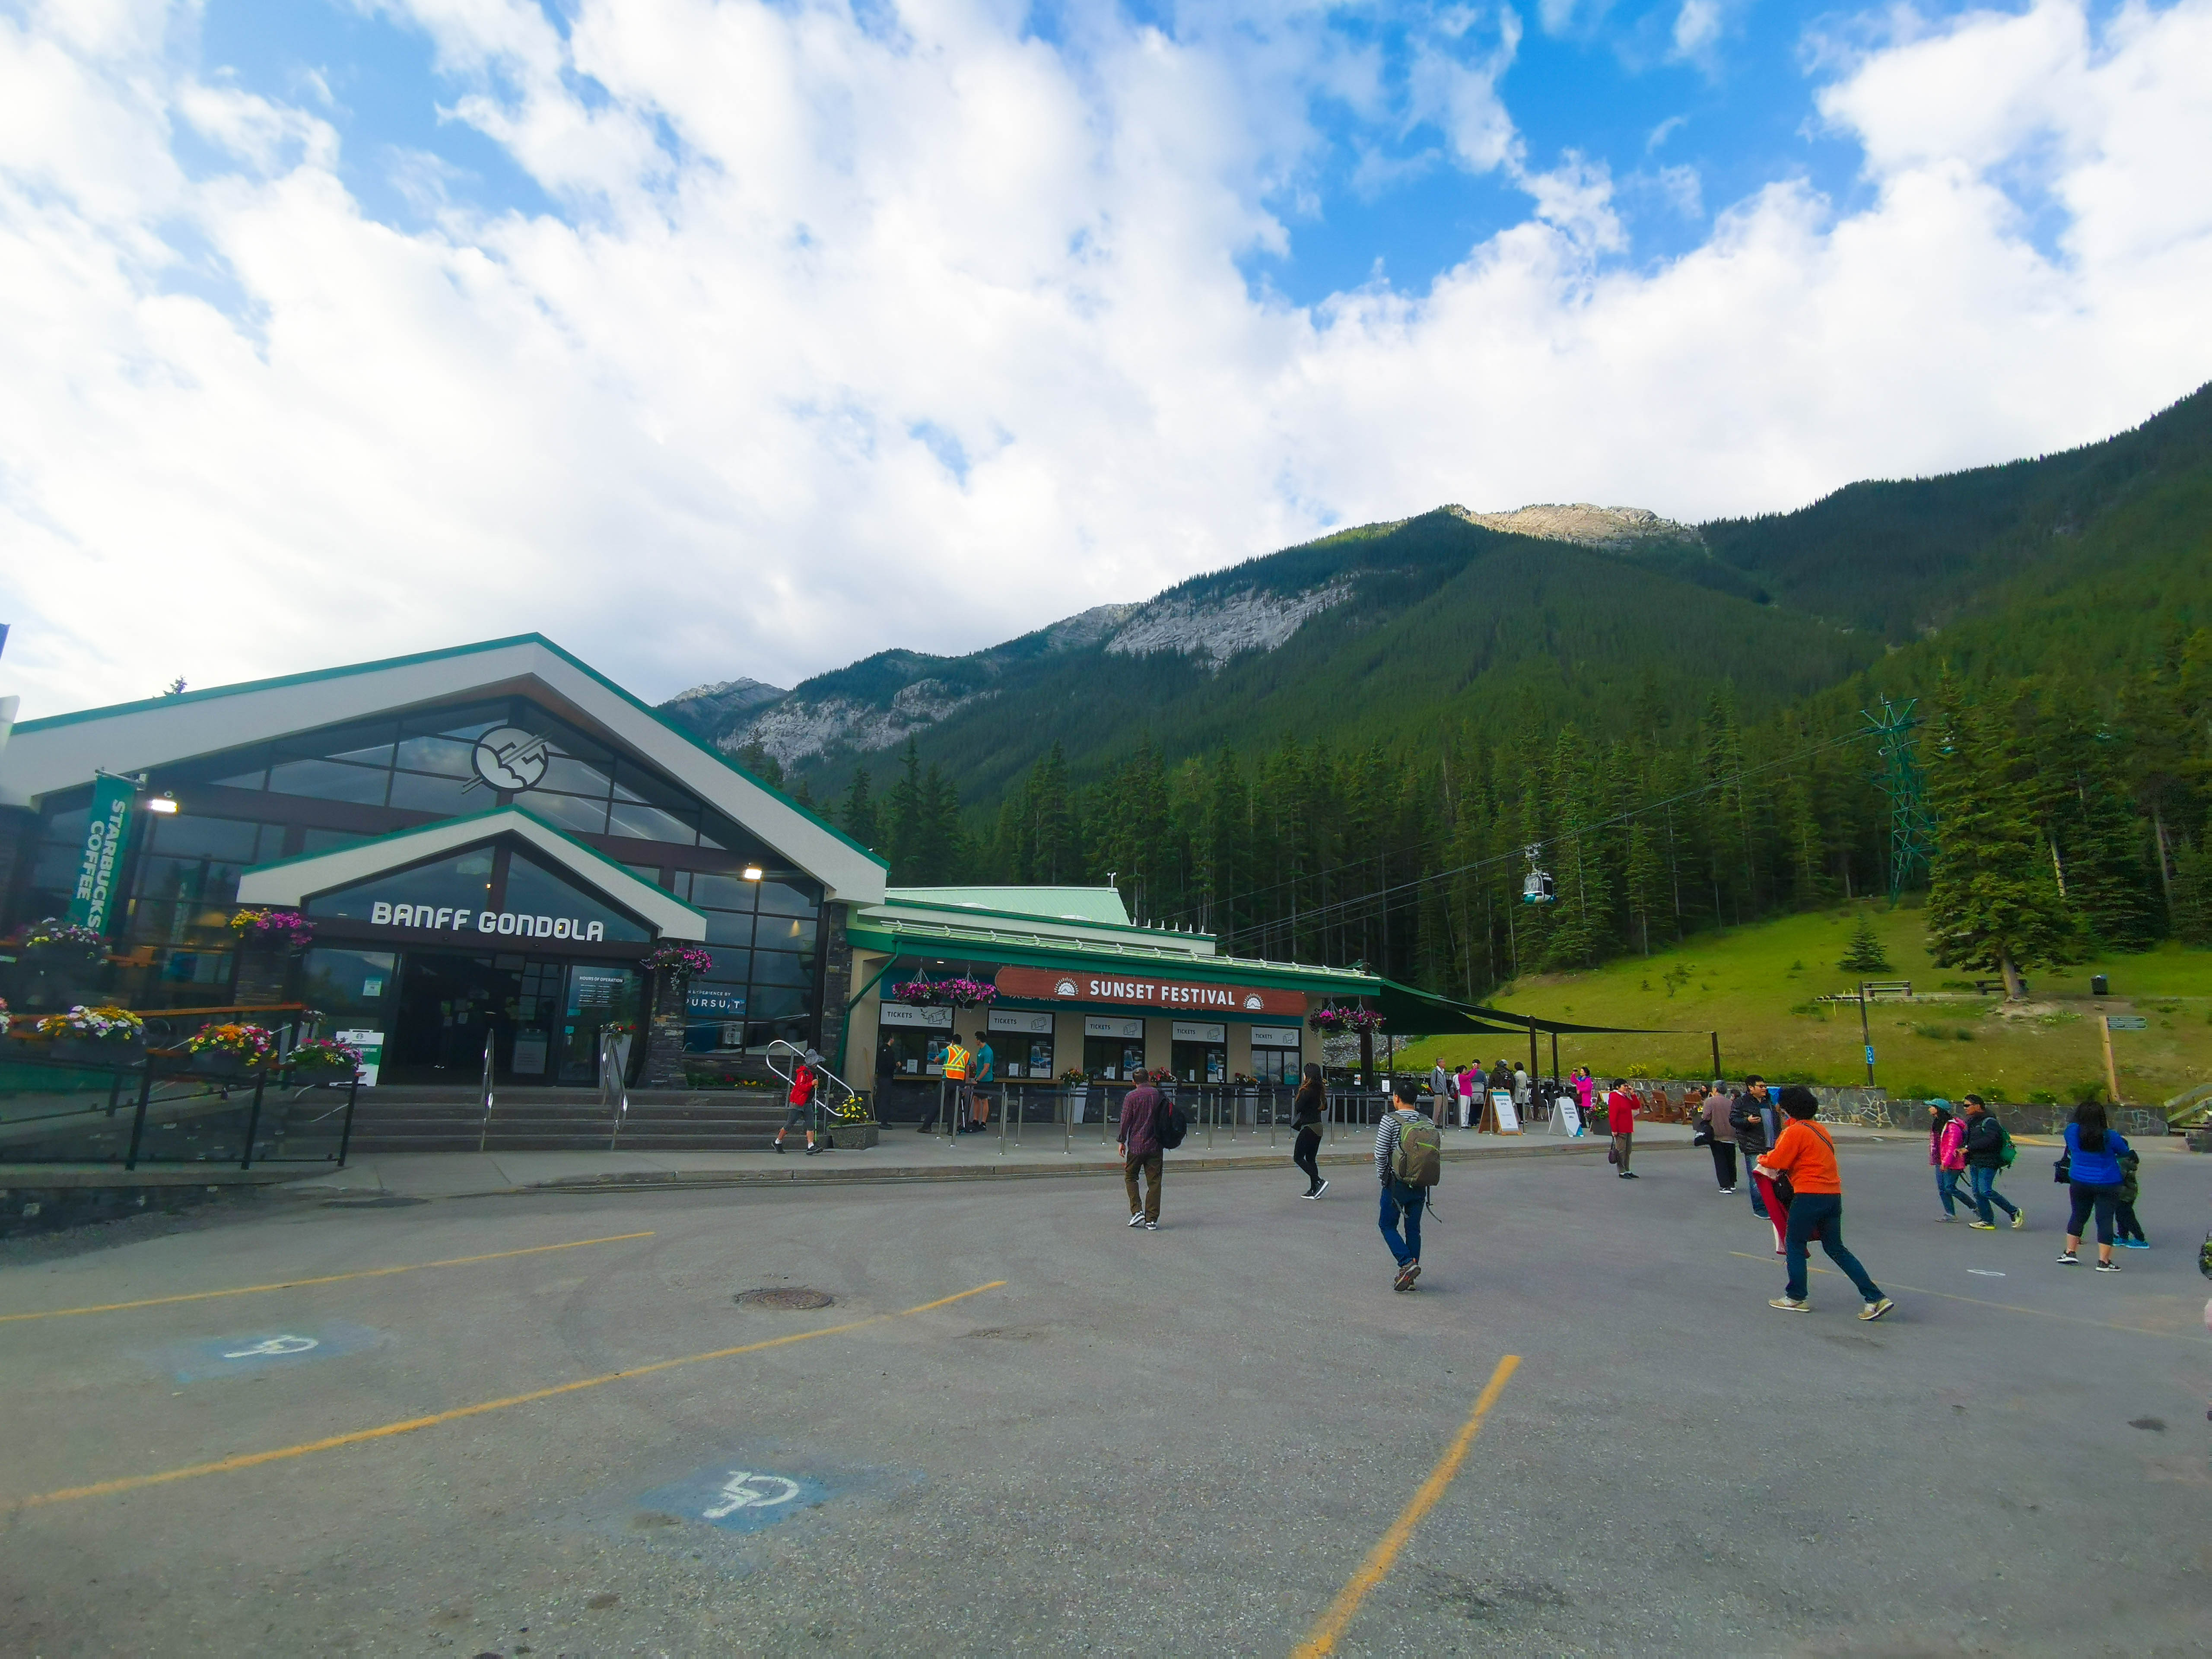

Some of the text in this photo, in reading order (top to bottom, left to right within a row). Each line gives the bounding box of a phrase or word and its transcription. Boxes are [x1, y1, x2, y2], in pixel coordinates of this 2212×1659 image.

[76, 820, 105, 900] COFFEE
[88, 799, 126, 928] STARBUCKS
[371, 901, 604, 942] BANFF GONDOLA
[1090, 980, 1236, 1006] SUNSET FESTIVAL
